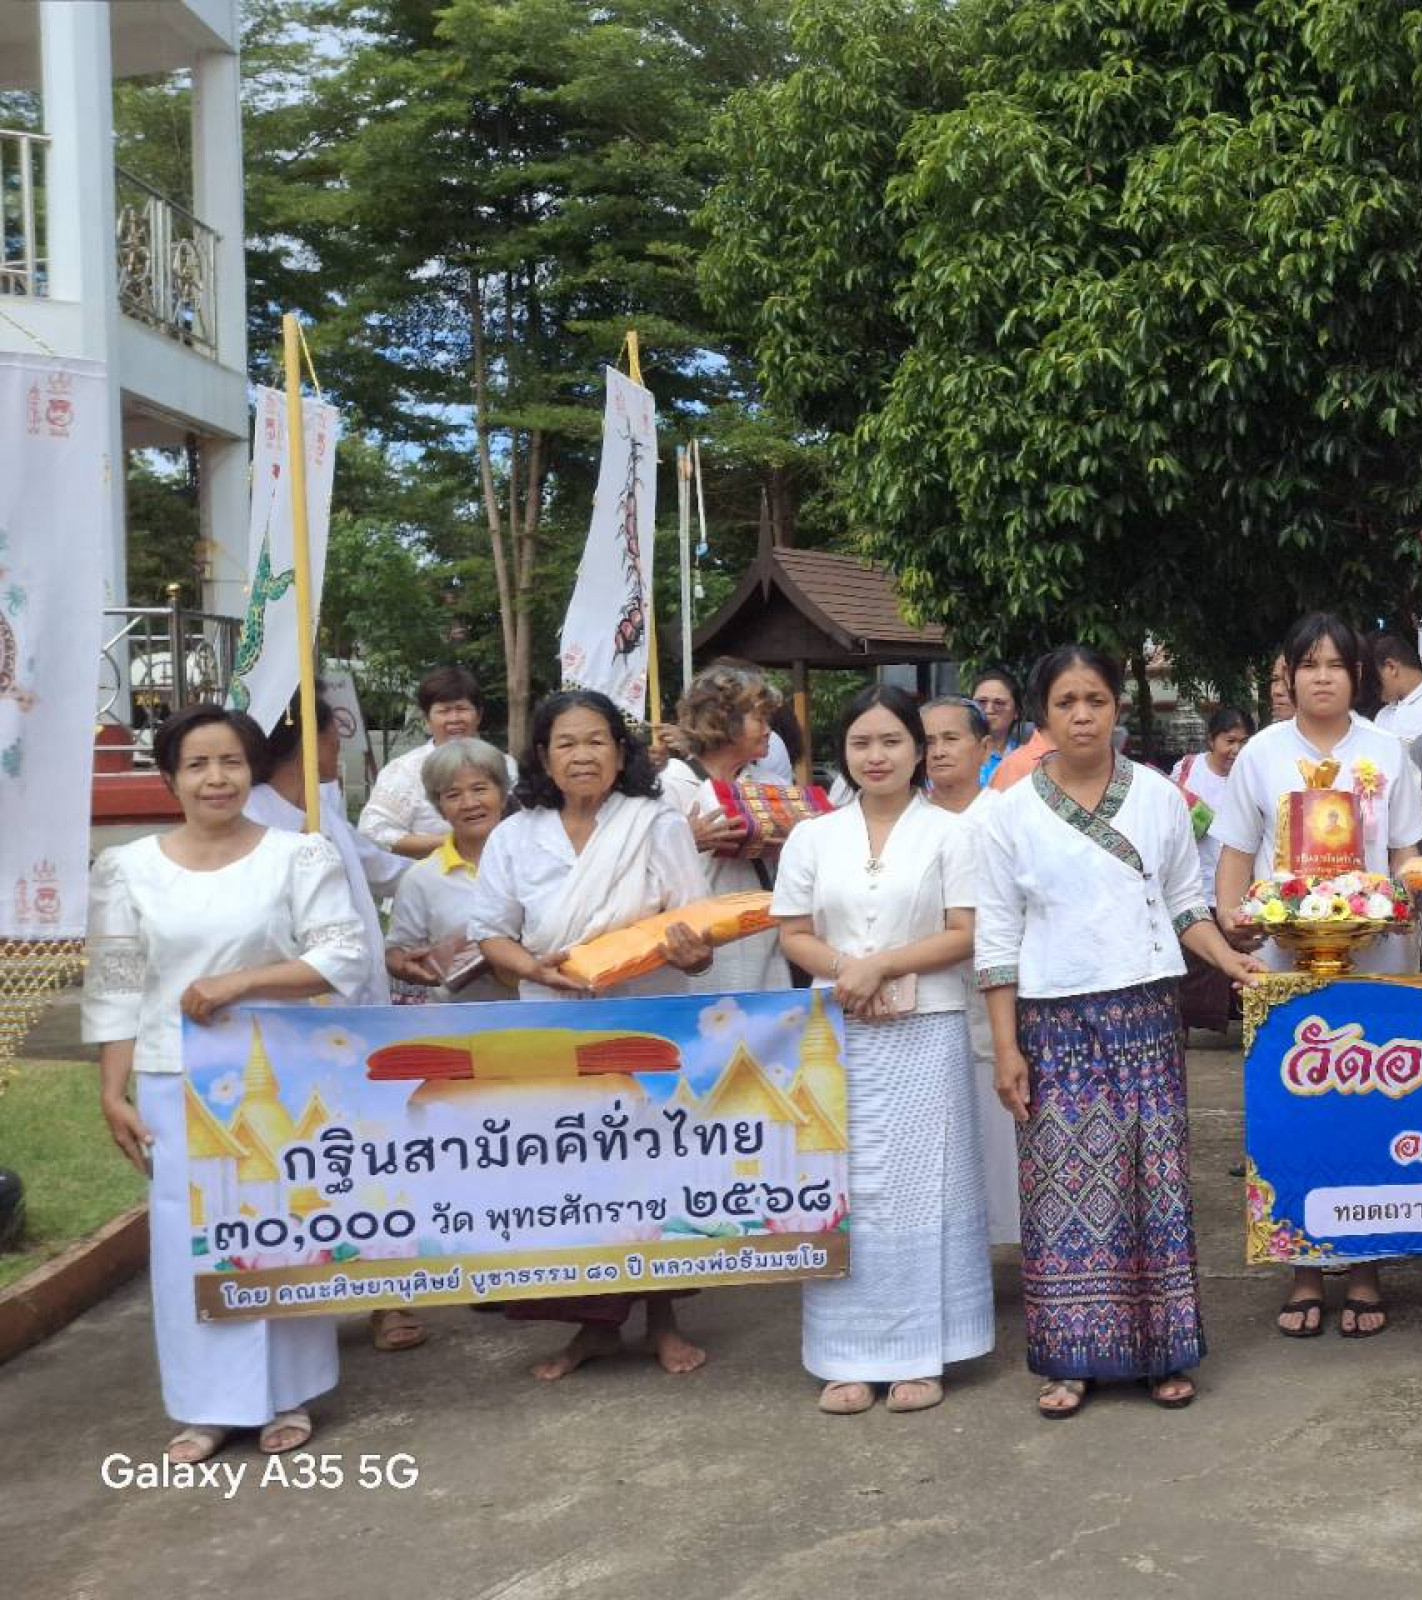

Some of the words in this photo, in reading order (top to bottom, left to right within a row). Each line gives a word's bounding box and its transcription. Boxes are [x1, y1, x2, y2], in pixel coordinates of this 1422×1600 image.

[284, 1100, 764, 1194] กฐินสามัคคีทั่วไทย
[213, 1210, 416, 1251] ๓๐,๐๐๐
[431, 1202, 474, 1233] วัด
[485, 1193, 667, 1241] พุทธศักราช
[682, 1179, 832, 1218] ๒๕๖๘
[223, 1285, 268, 1306] โดย
[278, 1267, 460, 1299] คณะศิษยานุศิษย์
